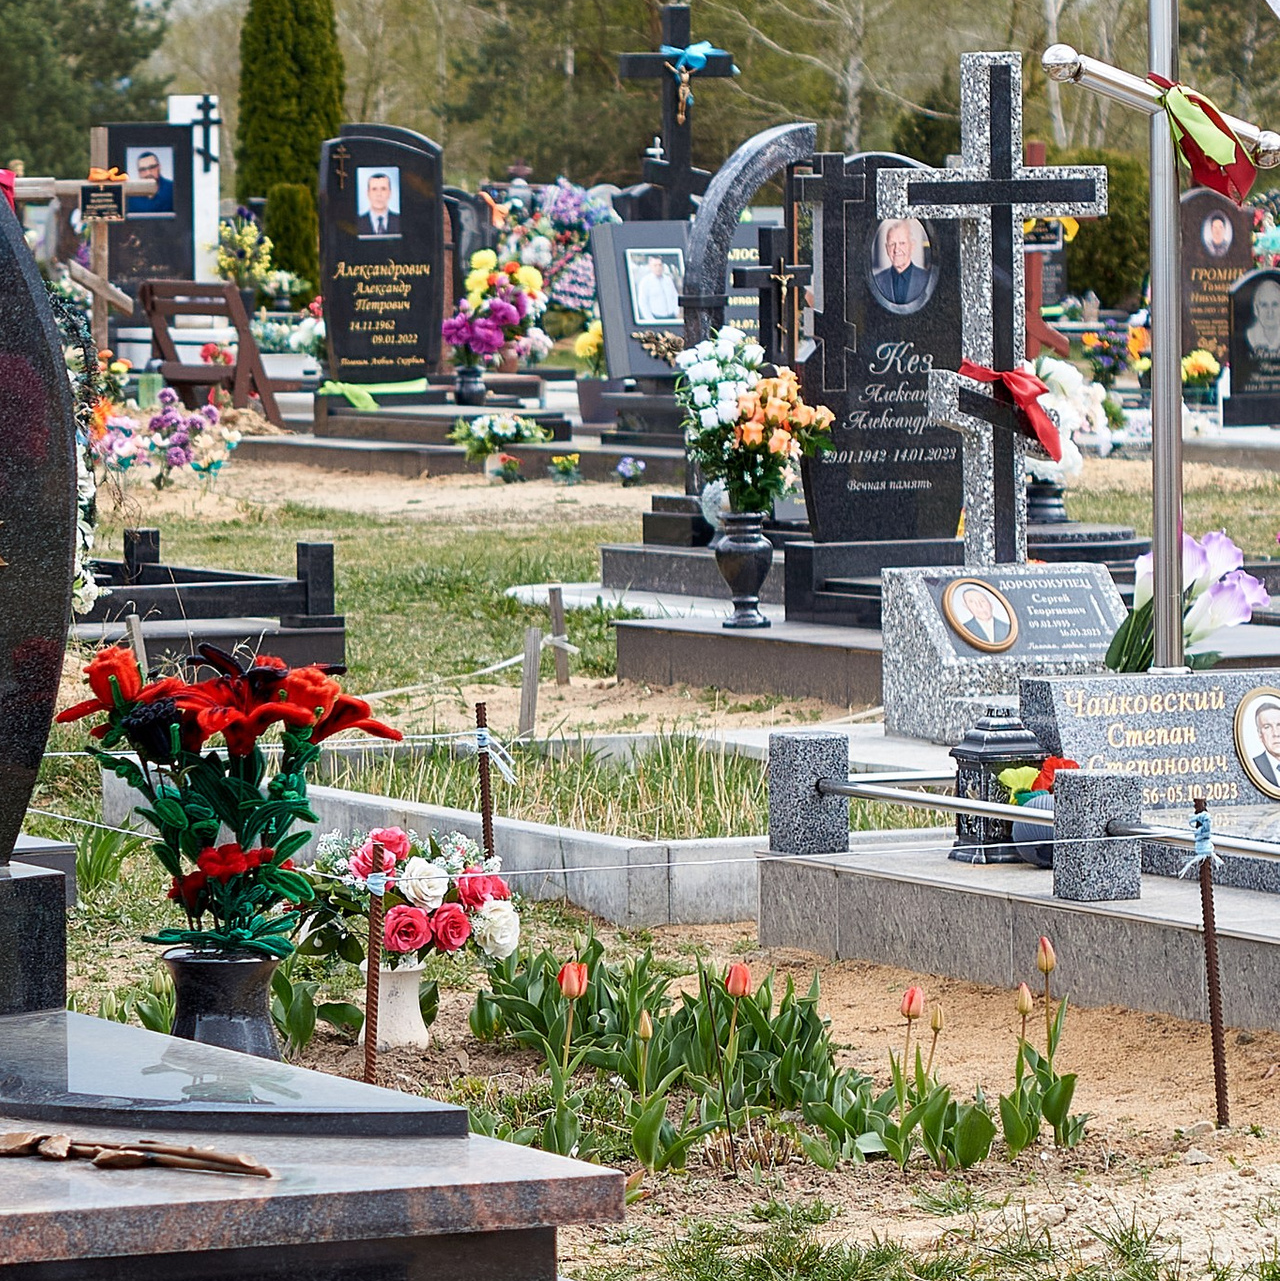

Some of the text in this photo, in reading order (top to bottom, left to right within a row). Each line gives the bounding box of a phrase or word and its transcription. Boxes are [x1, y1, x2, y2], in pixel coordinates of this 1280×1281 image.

[333, 258, 431, 281] Александрович
[353, 279, 412, 297] Александр
[355, 299, 411, 315] Петрович
[858, 381, 929, 408] Алексан
[892, 447, 957, 462] 14.01.2023
[847, 479, 933, 492] Вечная память
[999, 578, 1093, 591] ДОРОГОКУПЕЦ
[1031, 593, 1071, 605] Сергей
[1026, 605, 1087, 617] Георгиевич
[1064, 685, 1226, 718] Чайковский
[1107, 723, 1197, 748] Степан
